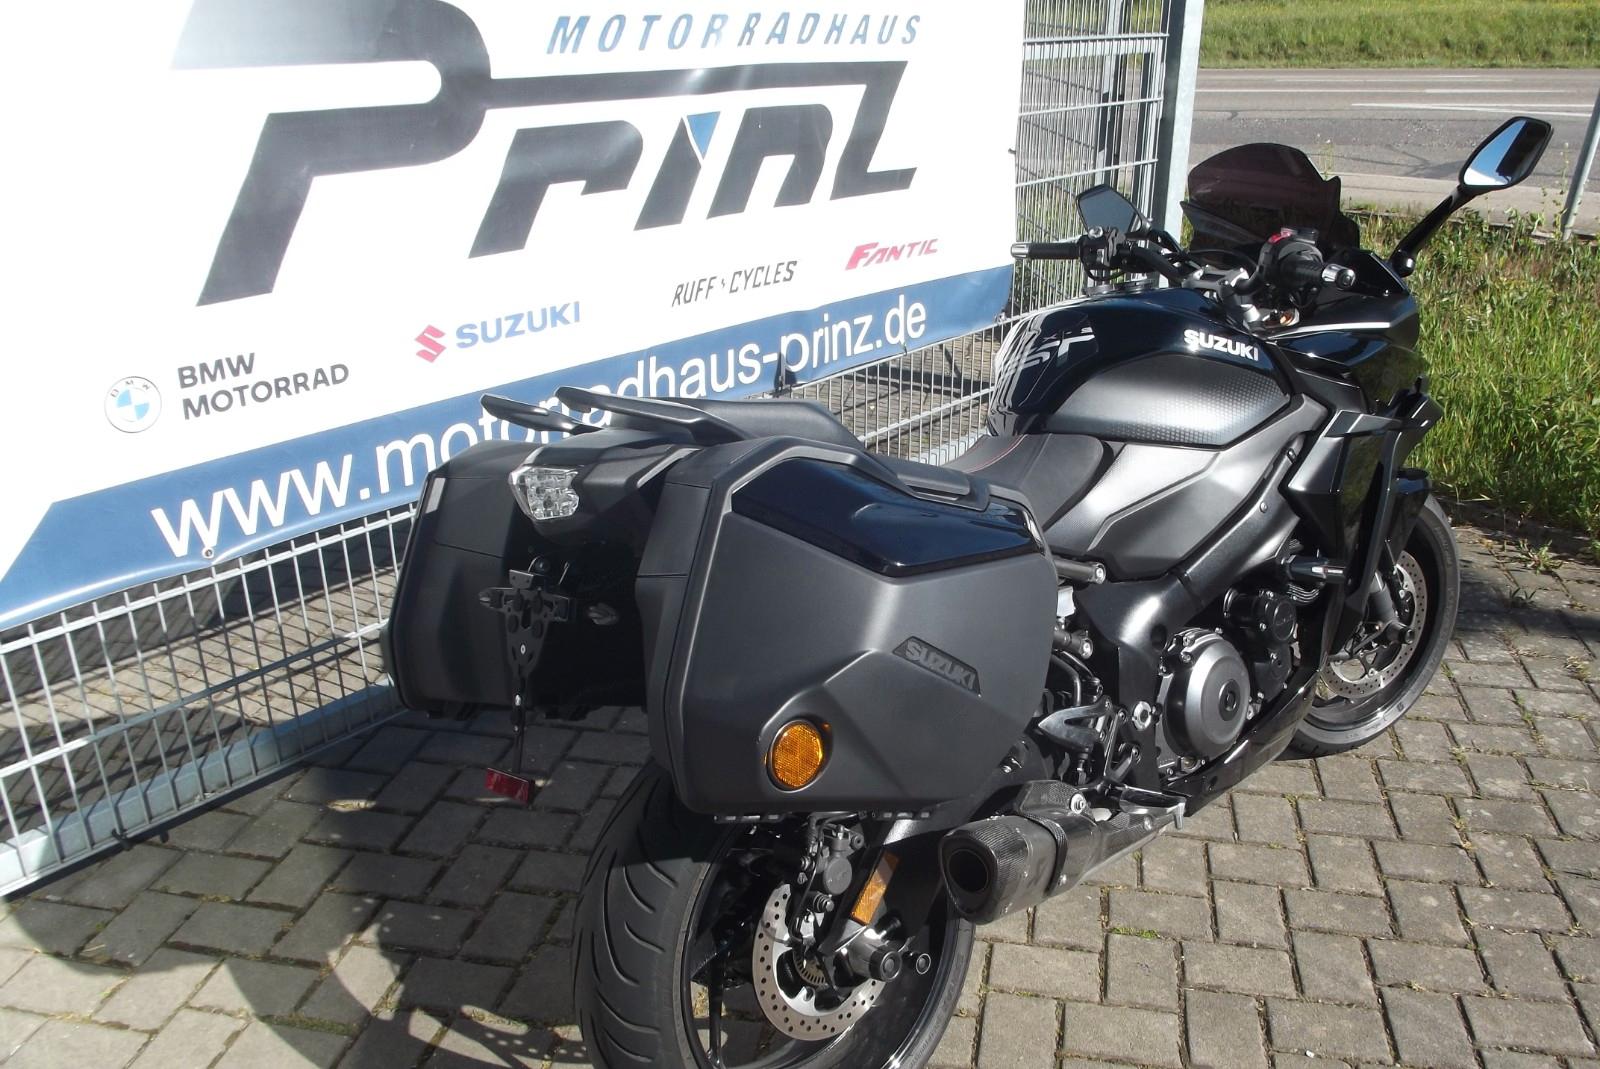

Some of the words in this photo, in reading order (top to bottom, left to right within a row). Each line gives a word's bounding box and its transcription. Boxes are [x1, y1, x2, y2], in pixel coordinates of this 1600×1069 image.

[546, 11, 922, 55] MOTORRADHAUS
[845, 238, 938, 271] FANTIC
[671, 275, 717, 307] RUFF
[729, 260, 798, 294] CYCLES
[455, 301, 580, 349] SUZUKI
[1183, 329, 1259, 361] SUZUKI
[178, 352, 255, 389] BMW
[182, 363, 350, 420] MOTORRAD
[905, 640, 977, 690] SUZUKI
